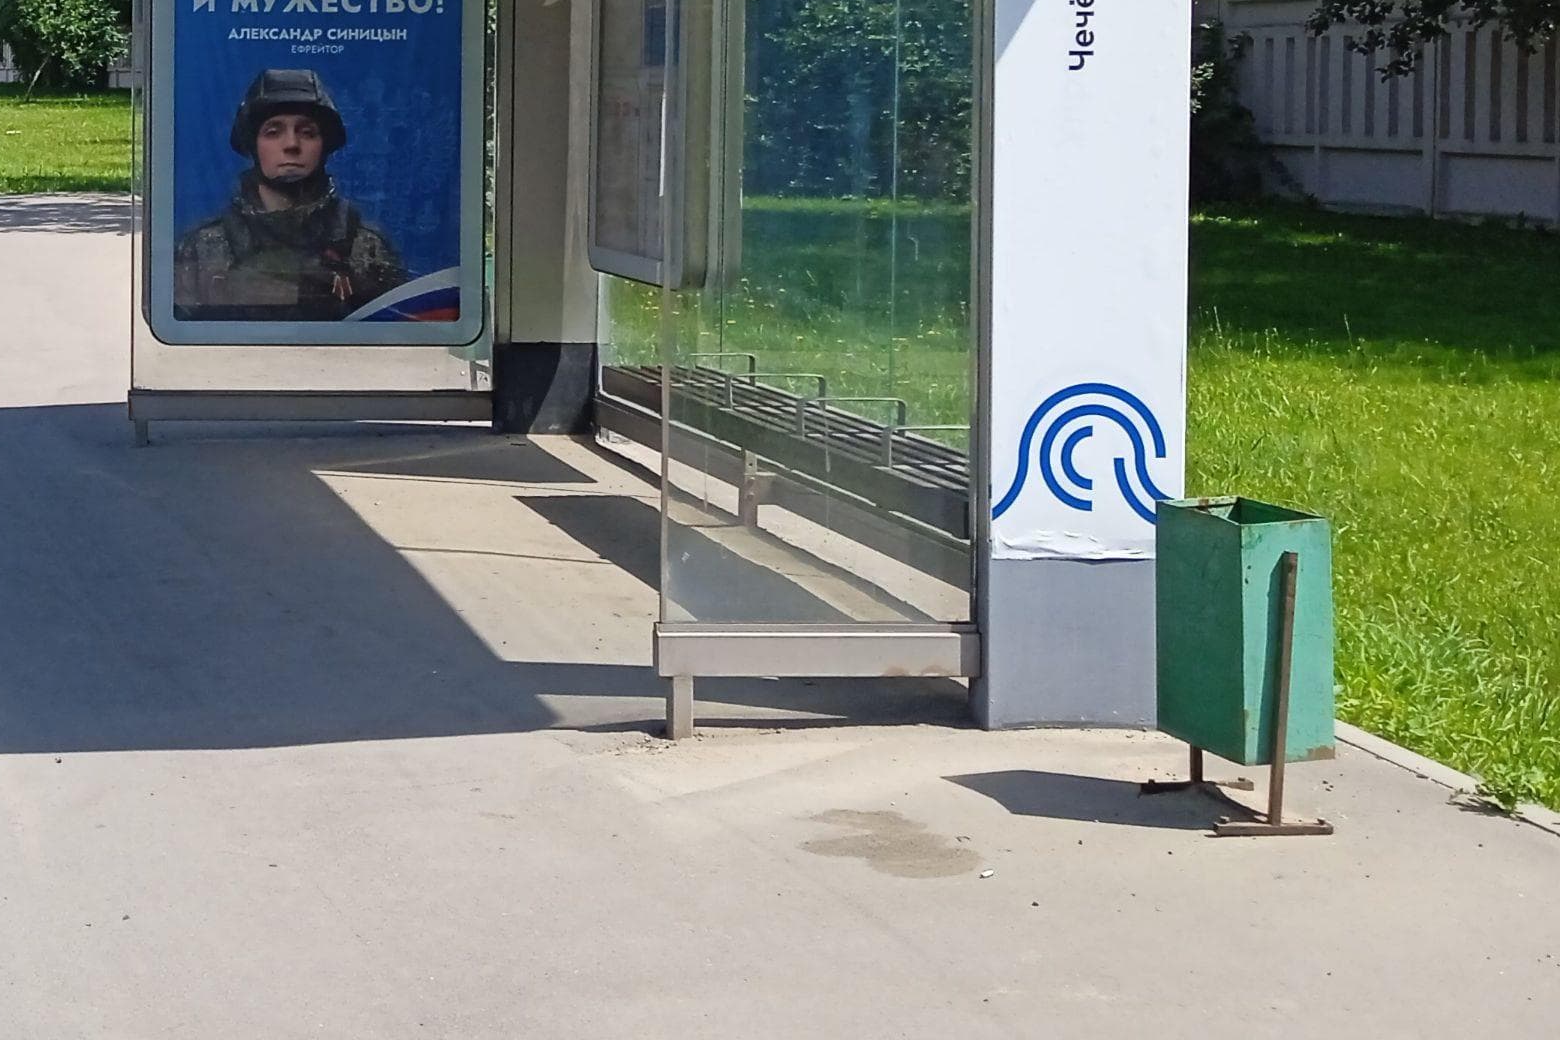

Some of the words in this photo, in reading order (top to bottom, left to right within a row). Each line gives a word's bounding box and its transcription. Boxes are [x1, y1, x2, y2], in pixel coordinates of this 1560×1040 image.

[228, 27, 323, 42] АЛЕКСАНДР
[326, 27, 408, 42] СИНИЦЫН
[290, 43, 345, 54] ЕФРЕЙТОР
